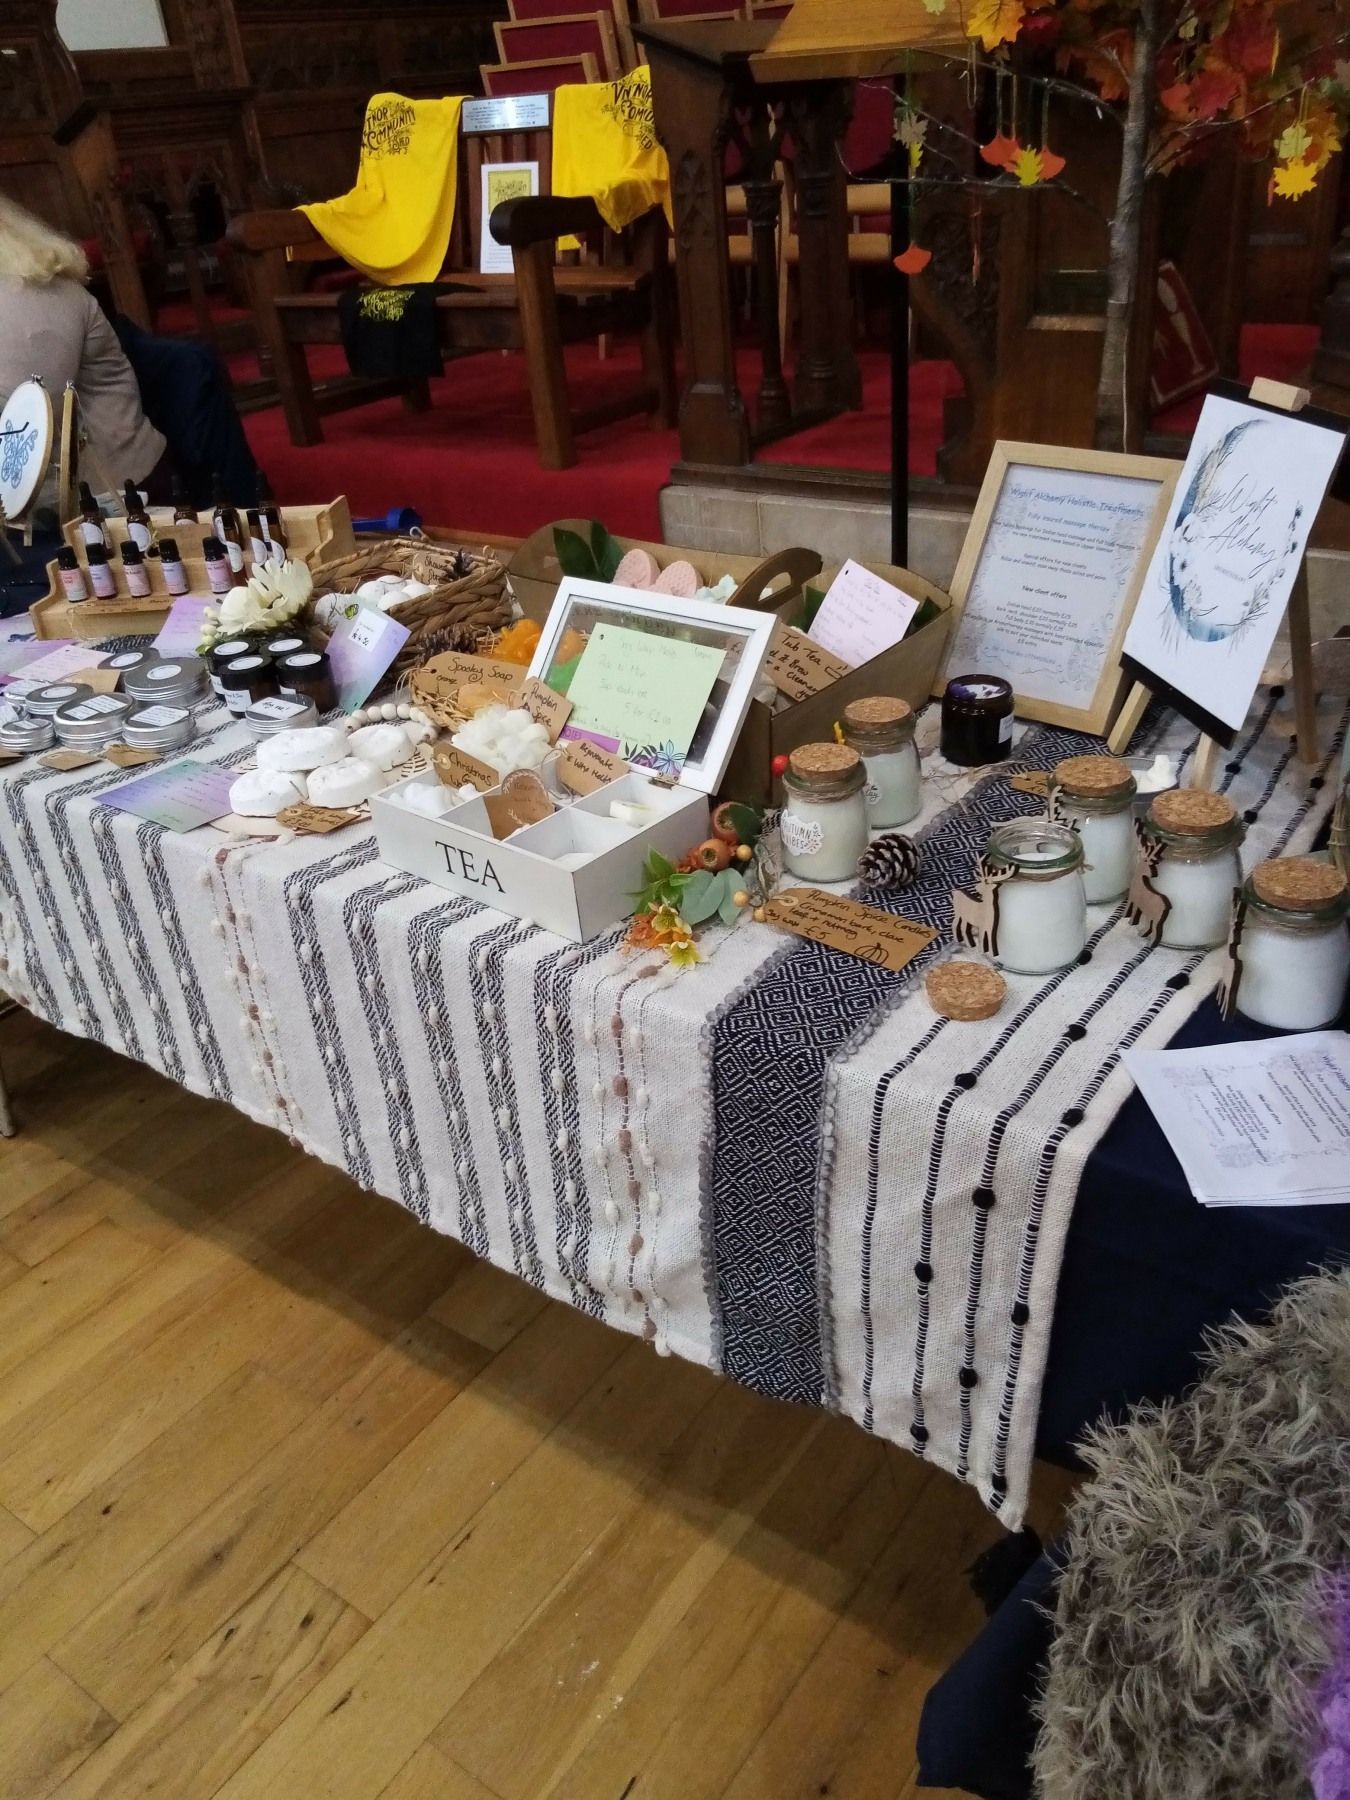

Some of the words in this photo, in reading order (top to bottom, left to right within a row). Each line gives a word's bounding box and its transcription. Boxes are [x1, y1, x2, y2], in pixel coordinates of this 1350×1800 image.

[1204, 515, 1277, 579] Alchemy
[448, 656, 483, 684] Spooky
[487, 664, 513, 683] Soap
[803, 647, 822, 666] Tea
[448, 751, 492, 786] Christmas
[435, 841, 506, 894] TEA
[799, 902, 848, 925] Cinnamon
[806, 889, 851, 912] Pumpkin
[853, 906, 889, 924] Spice
[893, 919, 931, 939] Candles
[822, 919, 859, 941] nutmeg
